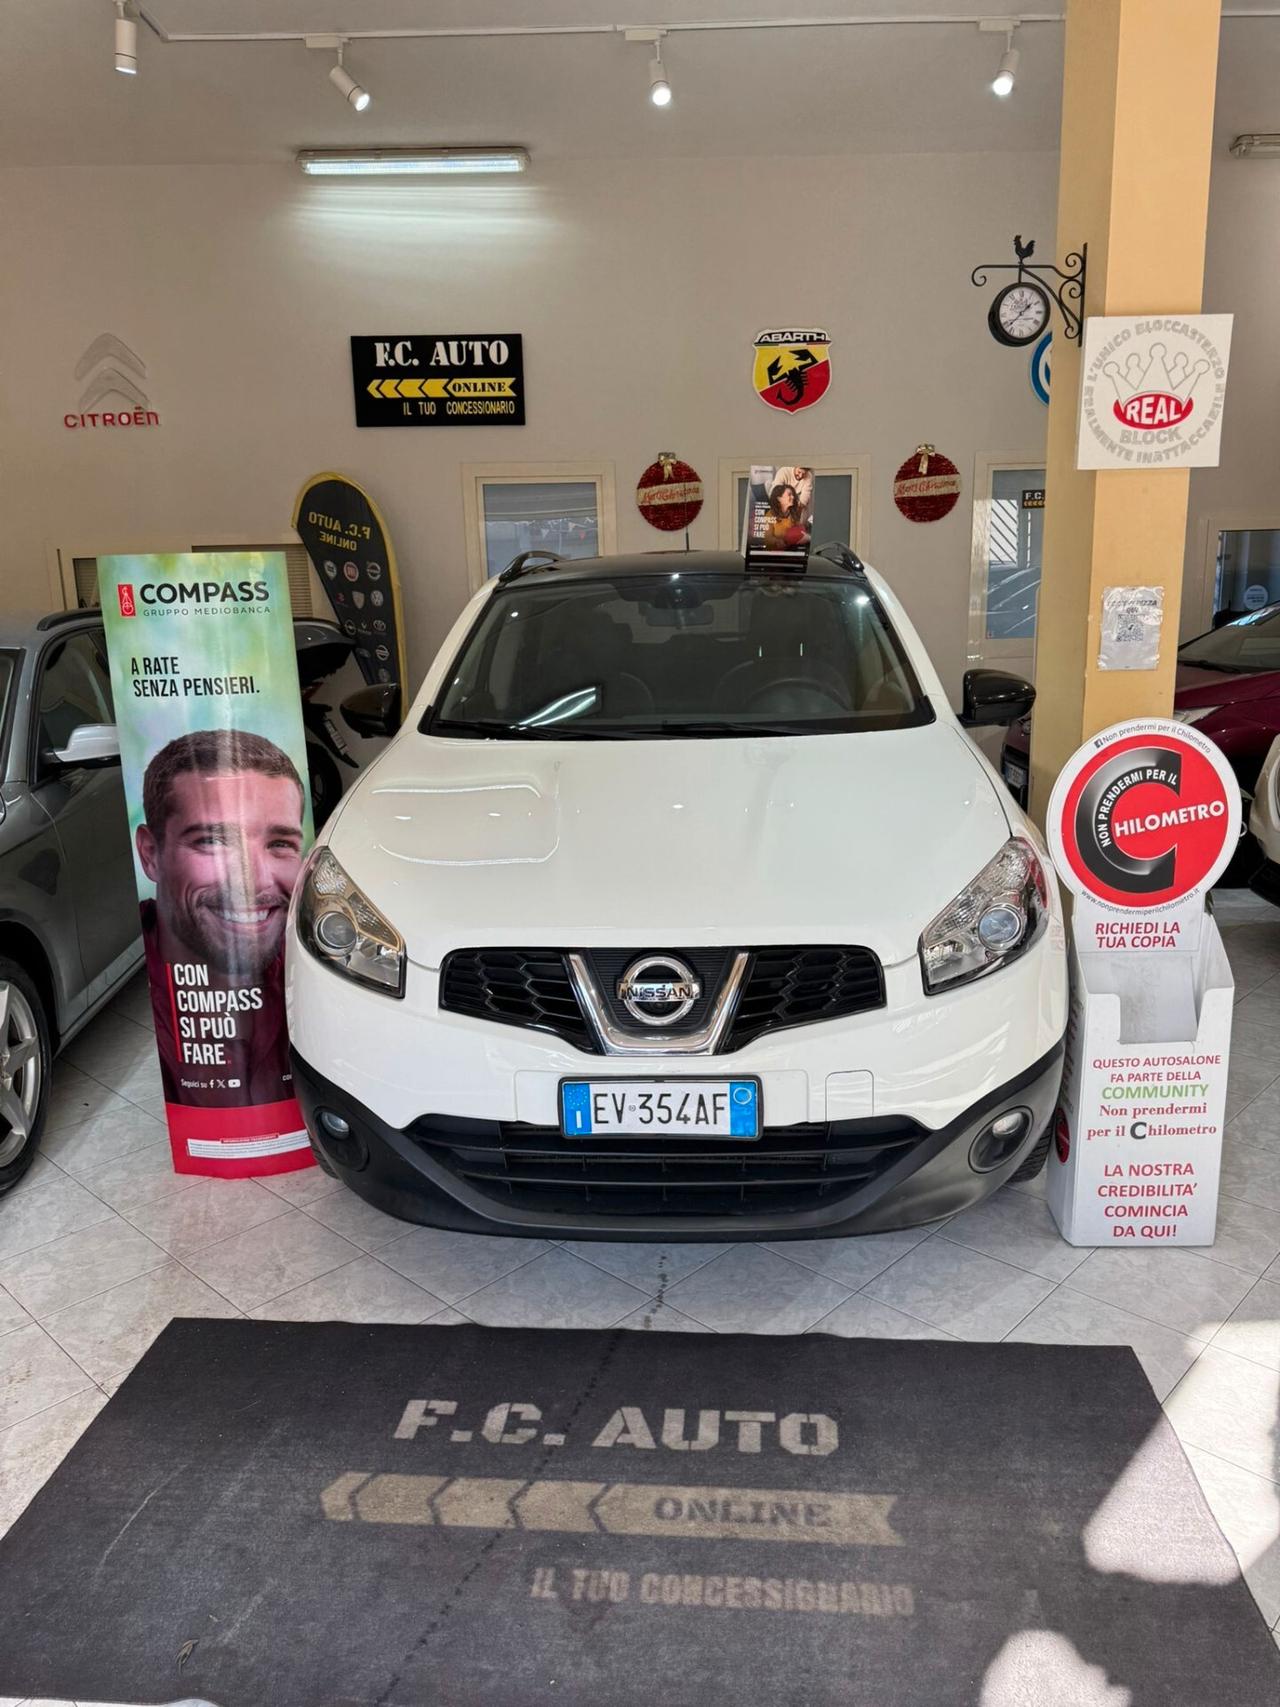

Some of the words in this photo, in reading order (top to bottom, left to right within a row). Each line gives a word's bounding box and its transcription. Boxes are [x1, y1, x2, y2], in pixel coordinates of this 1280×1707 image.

[760, 332, 825, 342] ABARTH
[374, 340, 420, 367] F.C.
[430, 340, 509, 367] AUTO
[452, 382, 506, 393] ONLINE
[403, 402, 412, 415] IL
[418, 401, 436, 415] TUO
[446, 400, 515, 415] CONCESSIONARIO
[1125, 396, 1182, 425] REAL
[1120, 426, 1183, 444] BLOCK
[140, 581, 270, 604] COMPASS
[143, 608, 189, 617] GRUPPO
[194, 606, 271, 616] MEDIOBANCA
[131, 657, 140, 675] A
[144, 656, 180, 675] RATE
[133, 679, 179, 697] SENZA
[184, 676, 260, 697] PENSIERI.
[1102, 732, 1118, 744] Non
[1119, 723, 1156, 737] prendermi
[1157, 724, 1170, 732] per
[1177, 727, 1211, 753] Chilometro
[1146, 769, 1165, 780] PER
[1168, 773, 1178, 785] IL
[1098, 768, 1143, 820] PRENDERMI
[1098, 820, 1112, 848] NON
[1095, 922, 1158, 935] RICHIEDI
[1163, 921, 1180, 933] LA
[1097, 936, 1126, 949] TUA
[1131, 935, 1176, 948] COPIA
[173, 963, 209, 987] CON
[626, 985, 692, 998] NISSAN
[176, 988, 263, 1013] COMPASS
[180, 1016, 196, 1039] SI
[200, 1012, 236, 1039] PUÒ
[1093, 1057, 1140, 1069] QUESTO
[1143, 1054, 1221, 1067] AUTOSALONE
[181, 1078, 200, 1088] Seguici
[1111, 1073, 1124, 1083] FA
[1127, 1072, 1163, 1082] PARTE
[1166, 1071, 1201, 1081] DELLA
[1102, 1084, 1209, 1100] COMMUNITY
[1100, 1105, 1127, 1116] Non
[1132, 1102, 1207, 1119] prendermi
[1087, 1127, 1110, 1140] per
[1115, 1125, 1125, 1137] il
[1130, 1121, 1217, 1140] Chilometro
[1104, 1164, 1123, 1177] LA
[1129, 1163, 1194, 1176] NOSTRA
[1104, 1204, 1188, 1218] COMINCIA
[1113, 1225, 1135, 1238] DA
[1140, 1225, 1177, 1239] QUI!
[394, 1400, 566, 1446] F.C.
[591, 1406, 839, 1456] AUTO
[653, 1496, 832, 1527] ONLINE
[530, 1566, 557, 1599] IL
[571, 1567, 630, 1602] TUO
[639, 1572, 915, 1616] CONCESSIONARIO
